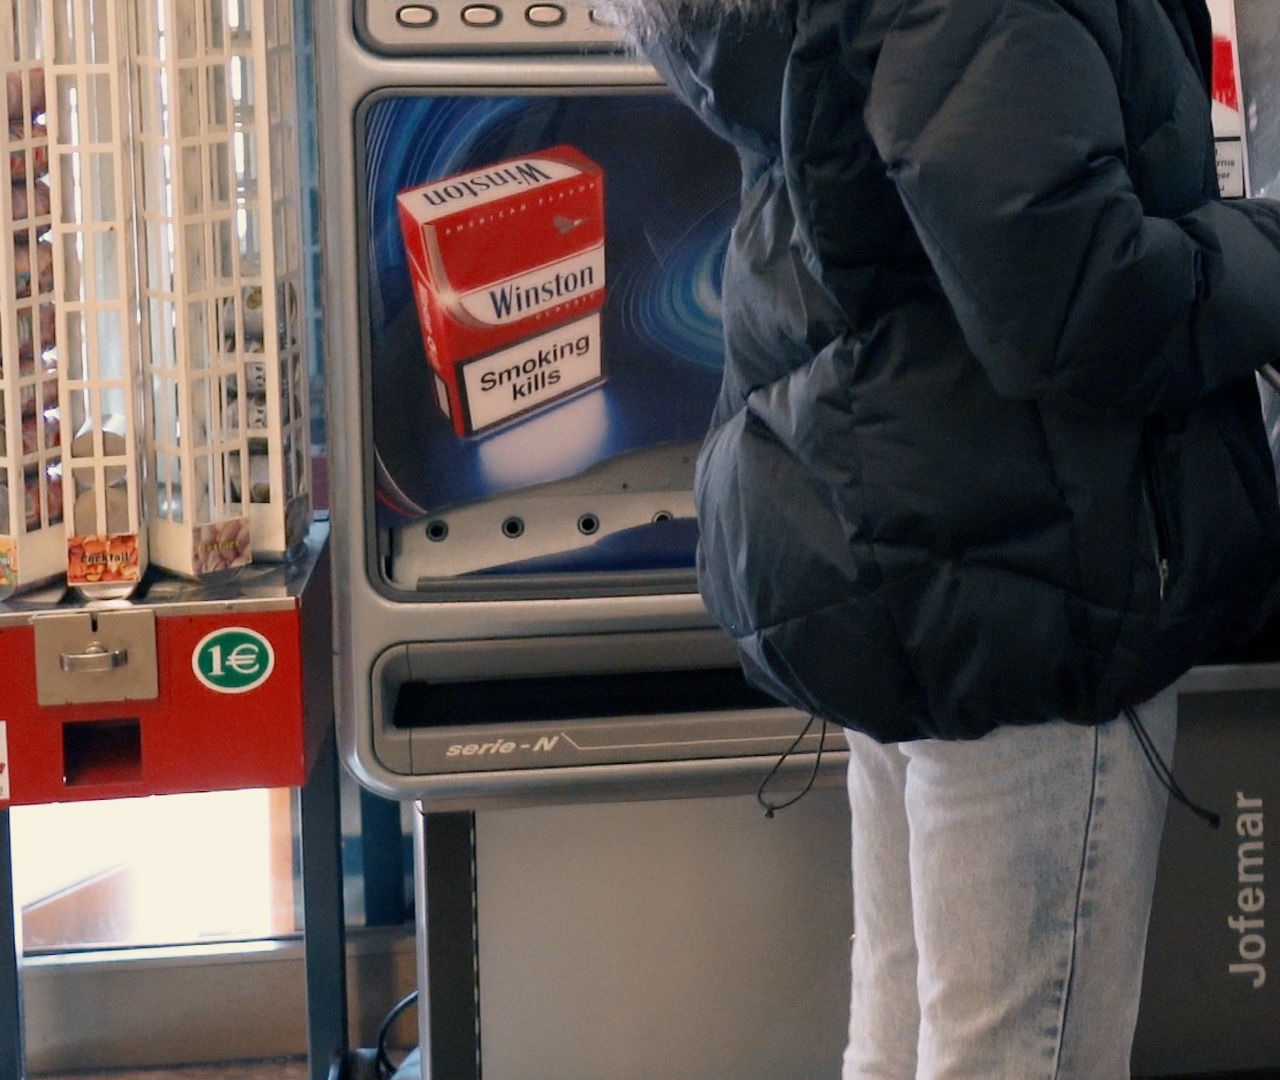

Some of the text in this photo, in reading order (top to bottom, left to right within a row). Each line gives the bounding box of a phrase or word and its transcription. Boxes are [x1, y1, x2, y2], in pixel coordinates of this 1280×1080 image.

[422, 161, 554, 208] Winston
[445, 203, 528, 236] AMERICAN
[489, 265, 595, 320] Winston
[480, 334, 591, 393] Smoking
[512, 369, 562, 401] kills
[80, 552, 130, 564] Cocktail
[207, 643, 260, 677] 1€
[1228, 791, 1268, 990] Jofemar
